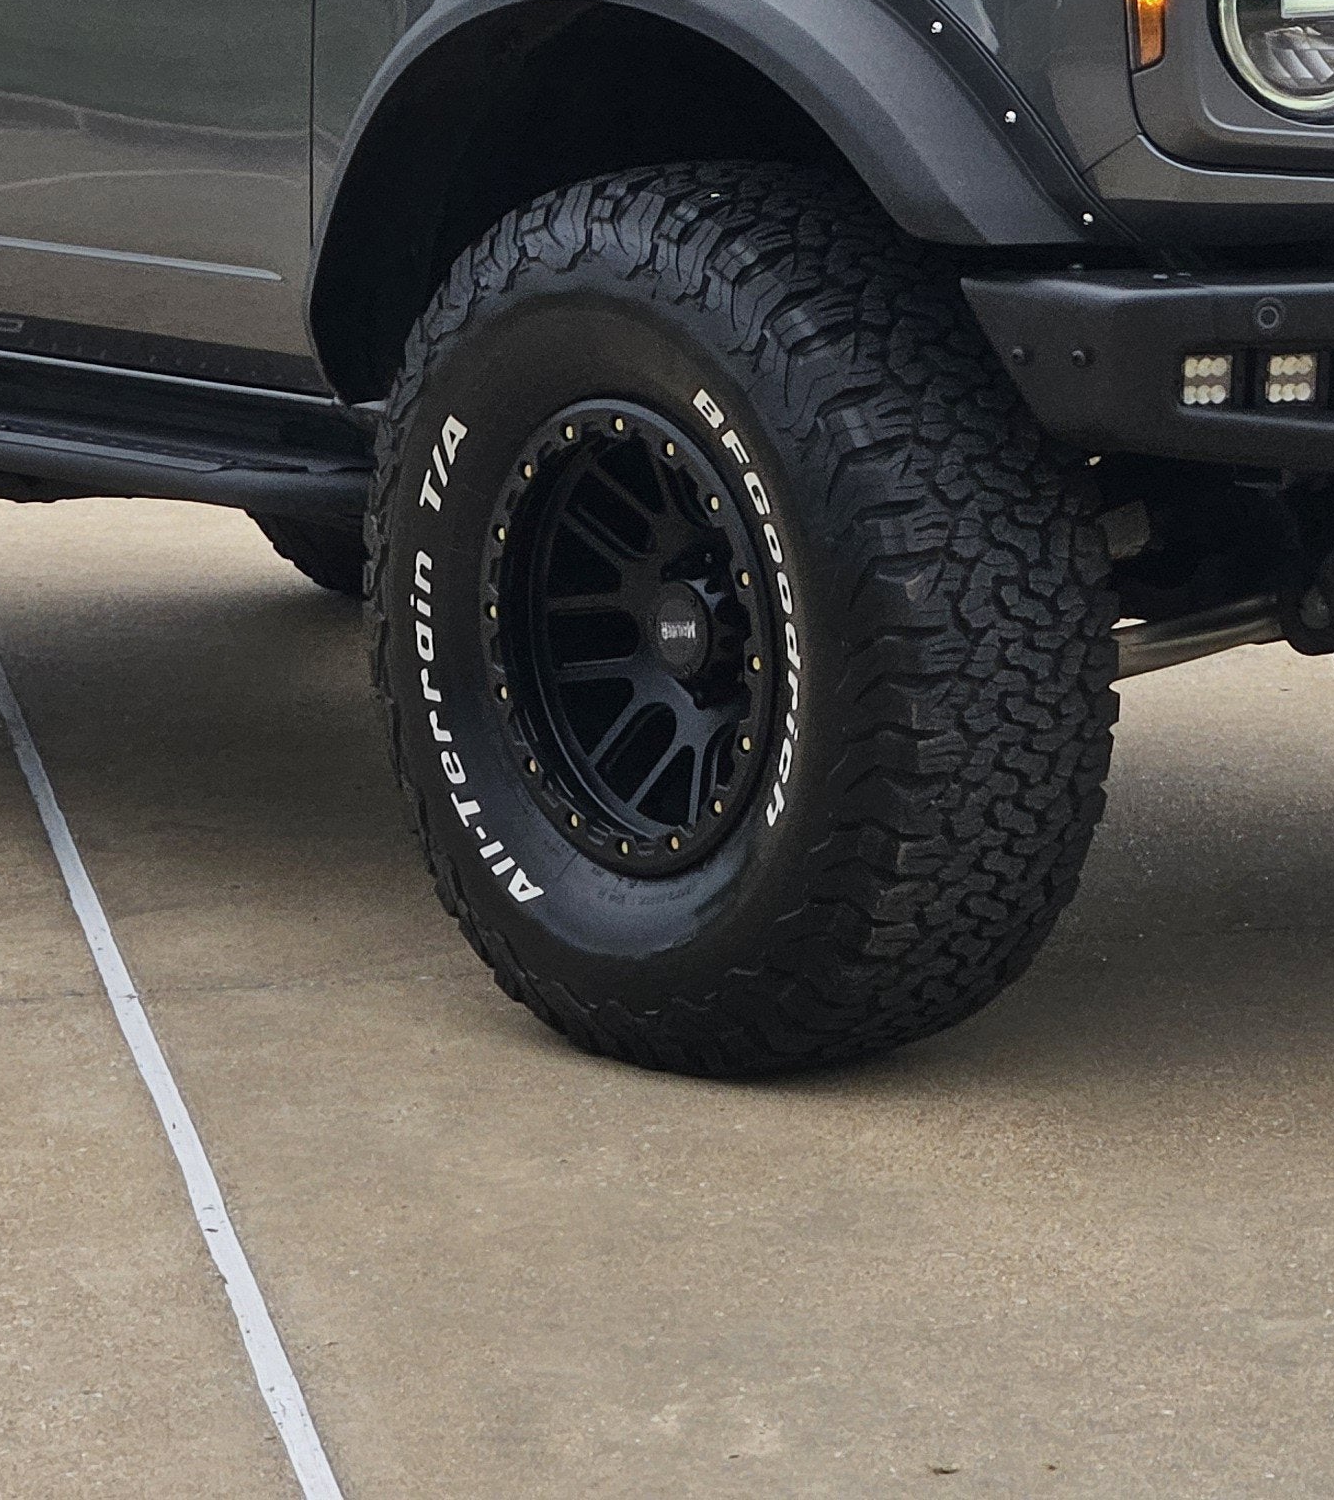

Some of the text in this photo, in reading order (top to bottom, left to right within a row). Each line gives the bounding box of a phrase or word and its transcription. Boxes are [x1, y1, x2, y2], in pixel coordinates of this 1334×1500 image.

[410, 414, 546, 904] All-Terrain T/A
[692, 389, 803, 828] BFGoodrich
